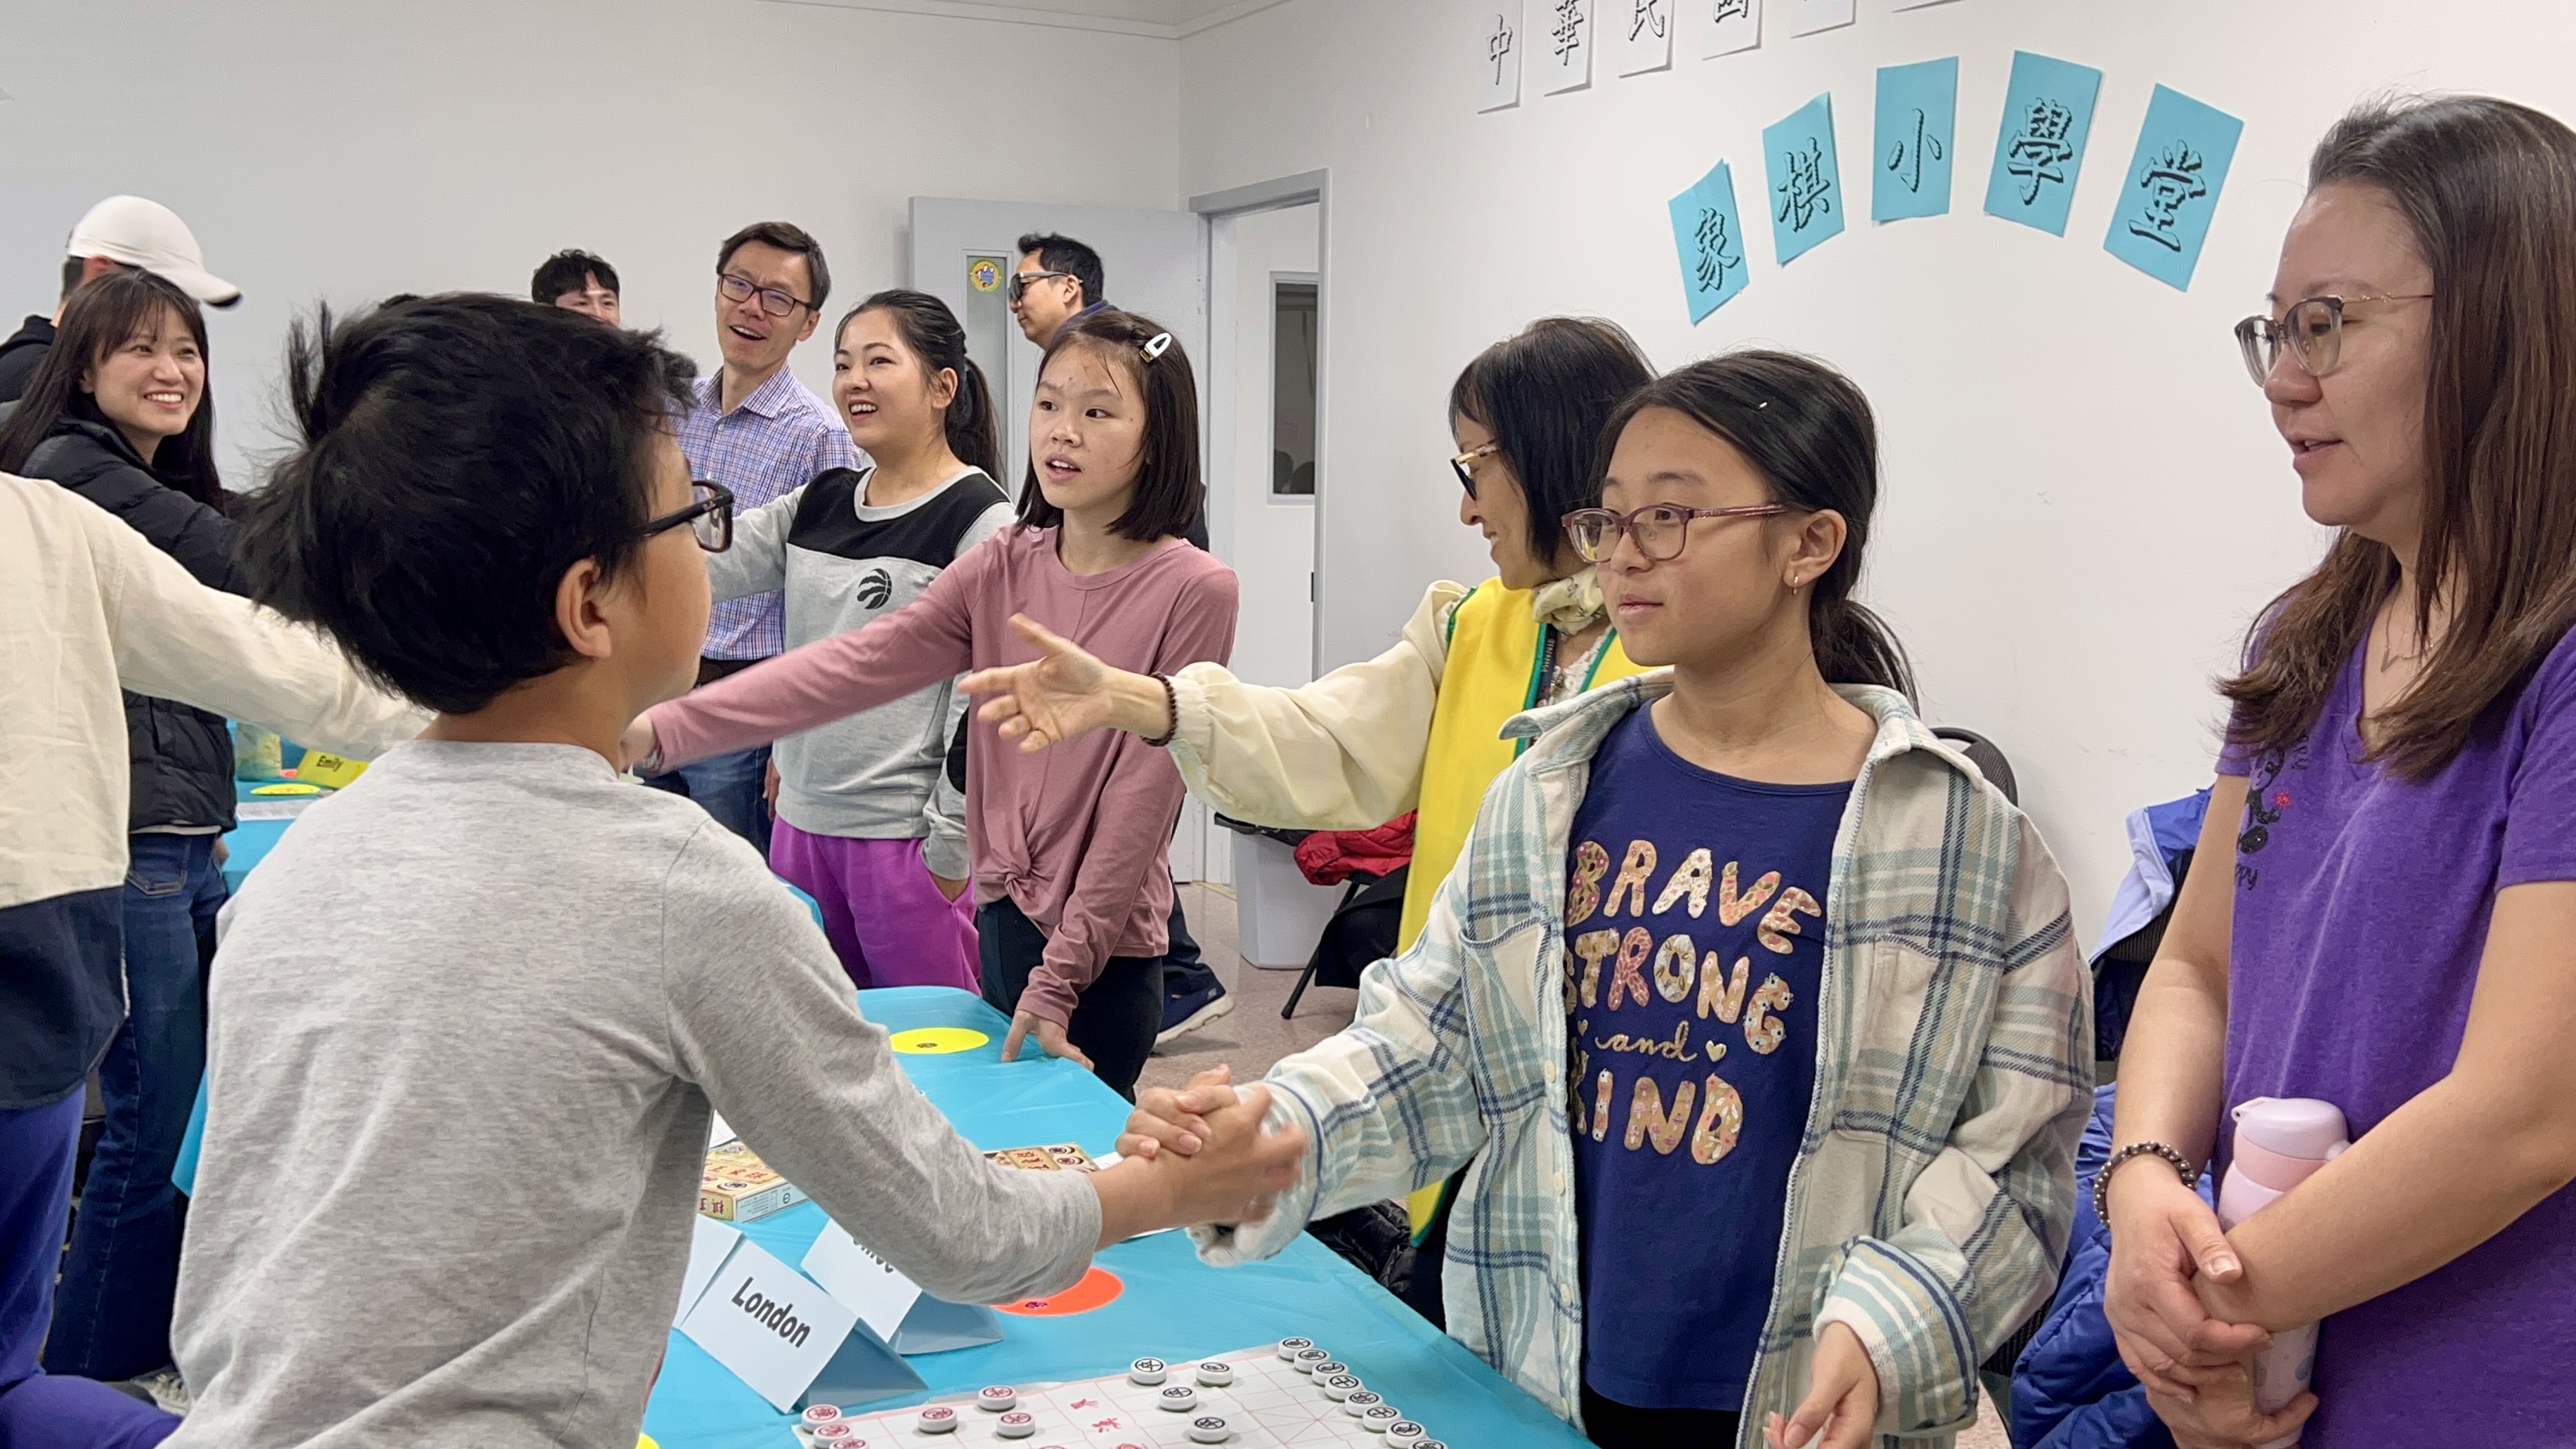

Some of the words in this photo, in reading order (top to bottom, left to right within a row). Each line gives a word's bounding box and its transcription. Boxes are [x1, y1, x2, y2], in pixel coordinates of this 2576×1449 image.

[1694, 97, 2206, 292] 象棋小學堂
[316, 755, 344, 772] Emily
[1565, 840, 1822, 954] BRAVE
[1595, 1020, 1698, 1061] and
[731, 1276, 811, 1349] London
